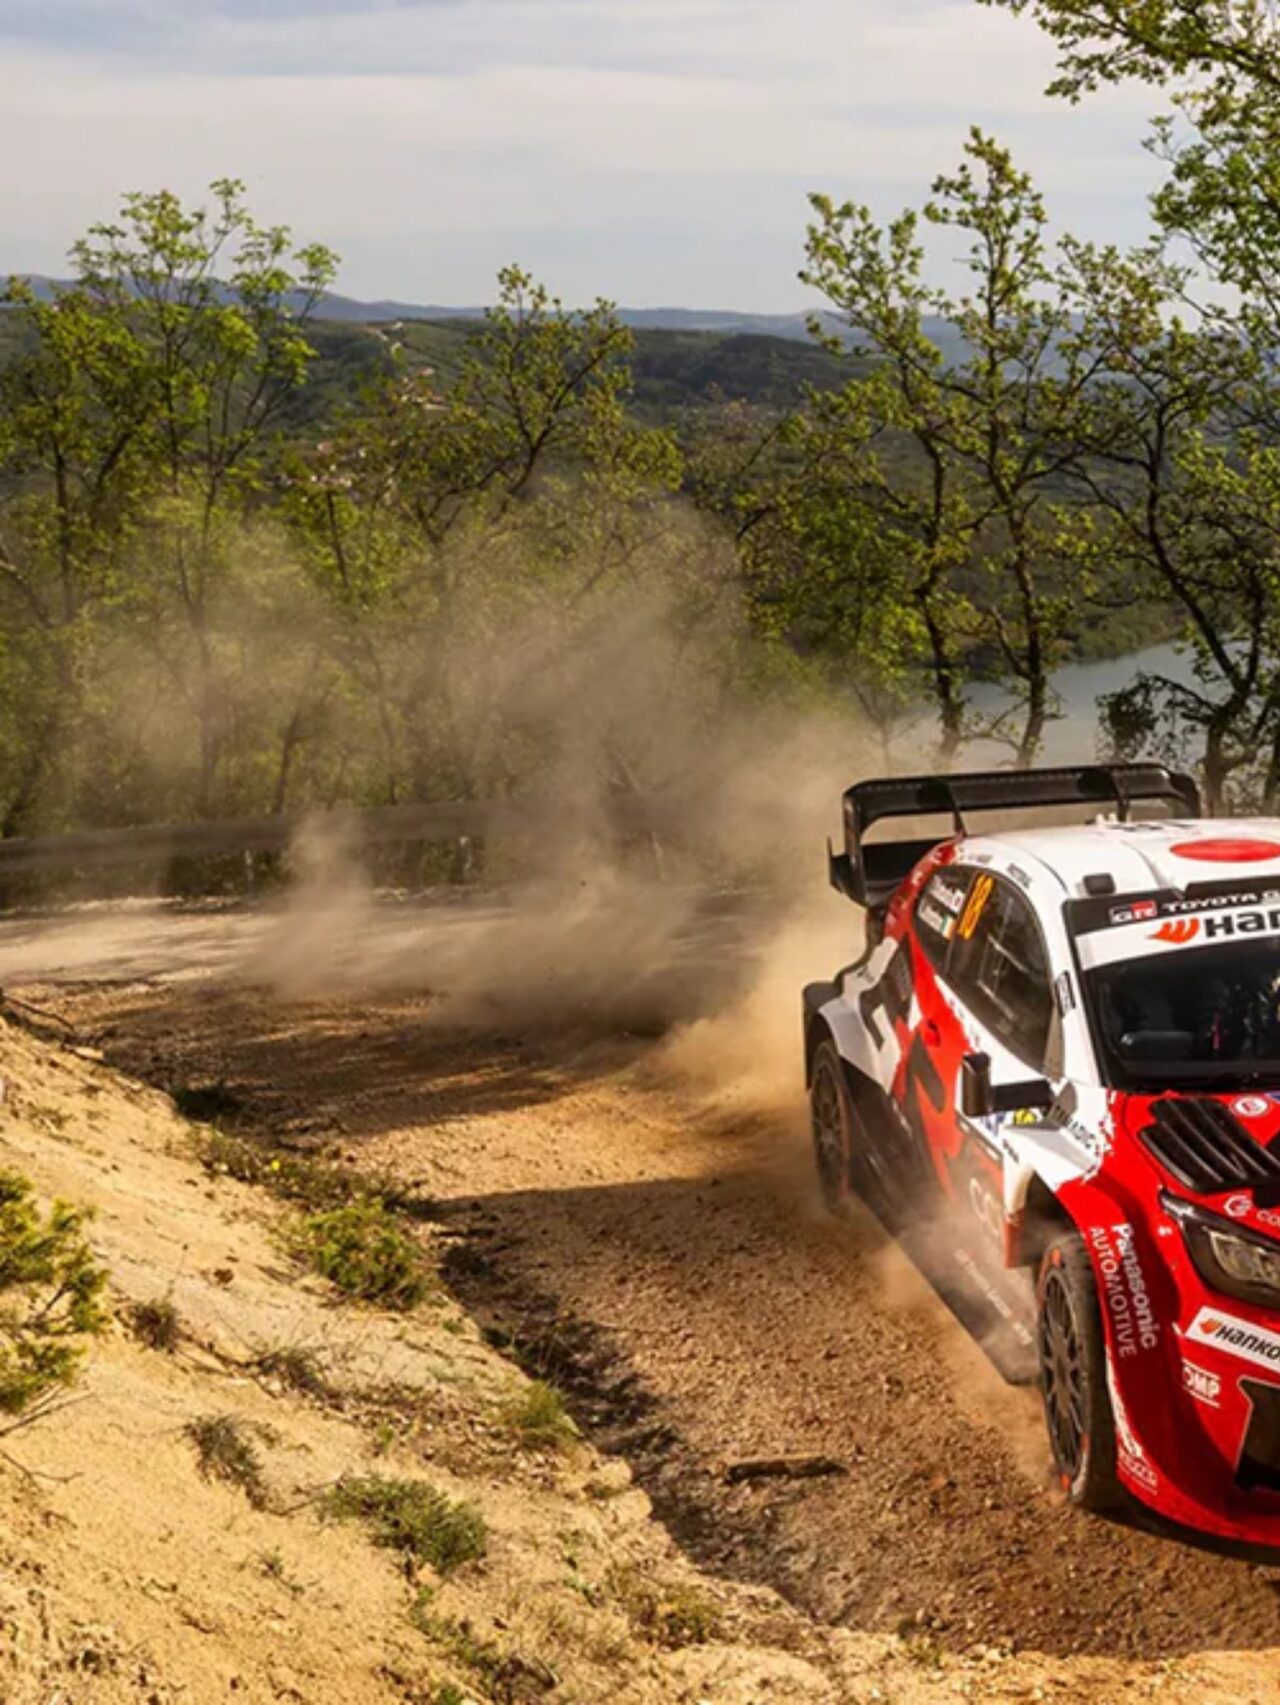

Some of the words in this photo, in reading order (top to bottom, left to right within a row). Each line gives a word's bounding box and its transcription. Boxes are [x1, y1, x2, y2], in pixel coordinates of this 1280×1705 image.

[1163, 893, 1258, 912] TOYOTA
[1089, 1226, 1137, 1358] AUTOMOTIVE
[1112, 1223, 1158, 1349] Panasonic
